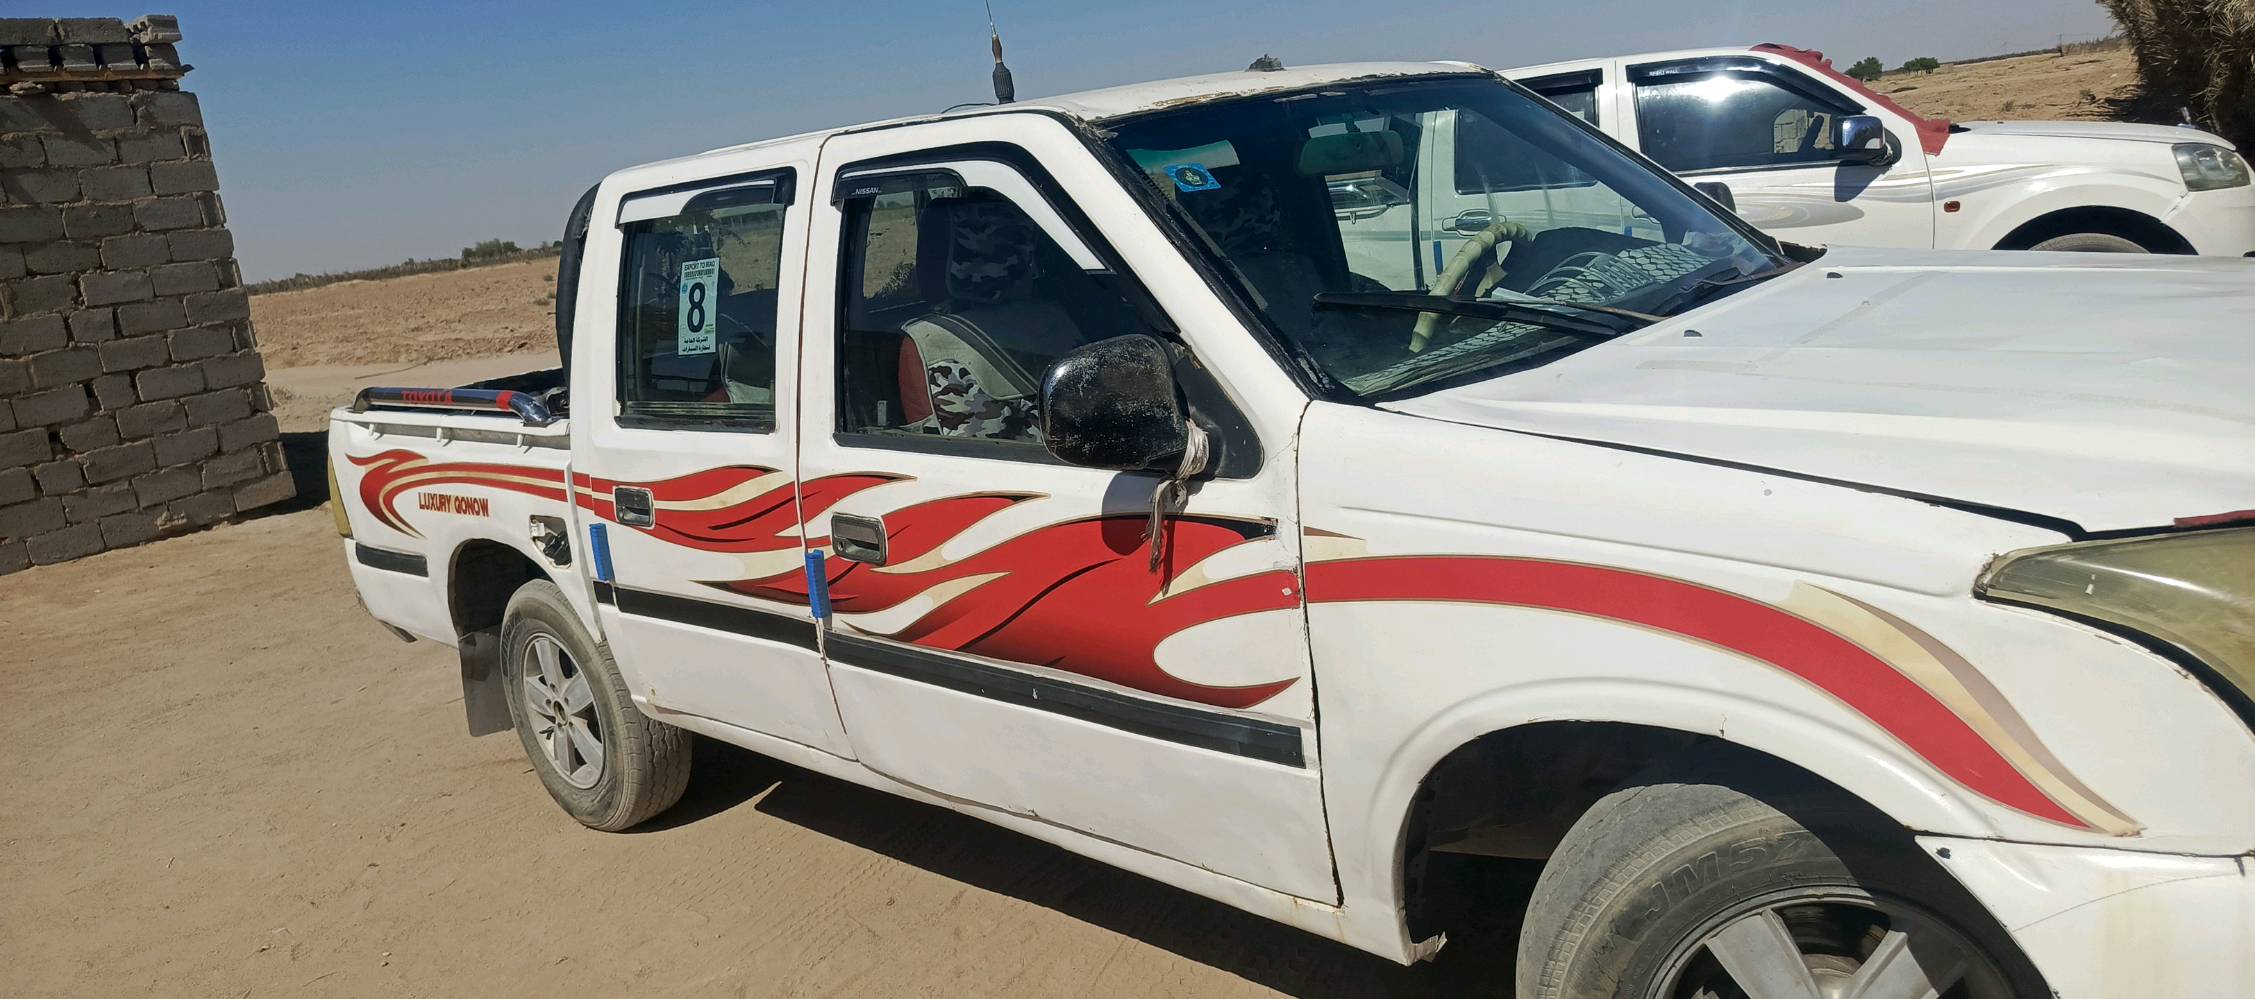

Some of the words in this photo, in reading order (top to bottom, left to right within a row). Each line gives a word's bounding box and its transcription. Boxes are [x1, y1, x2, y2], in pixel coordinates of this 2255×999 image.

[855, 186, 880, 195] NISSAN
[687, 282, 706, 333] 8
[418, 492, 452, 513] LUXURY
[454, 495, 490, 518] GONOW
